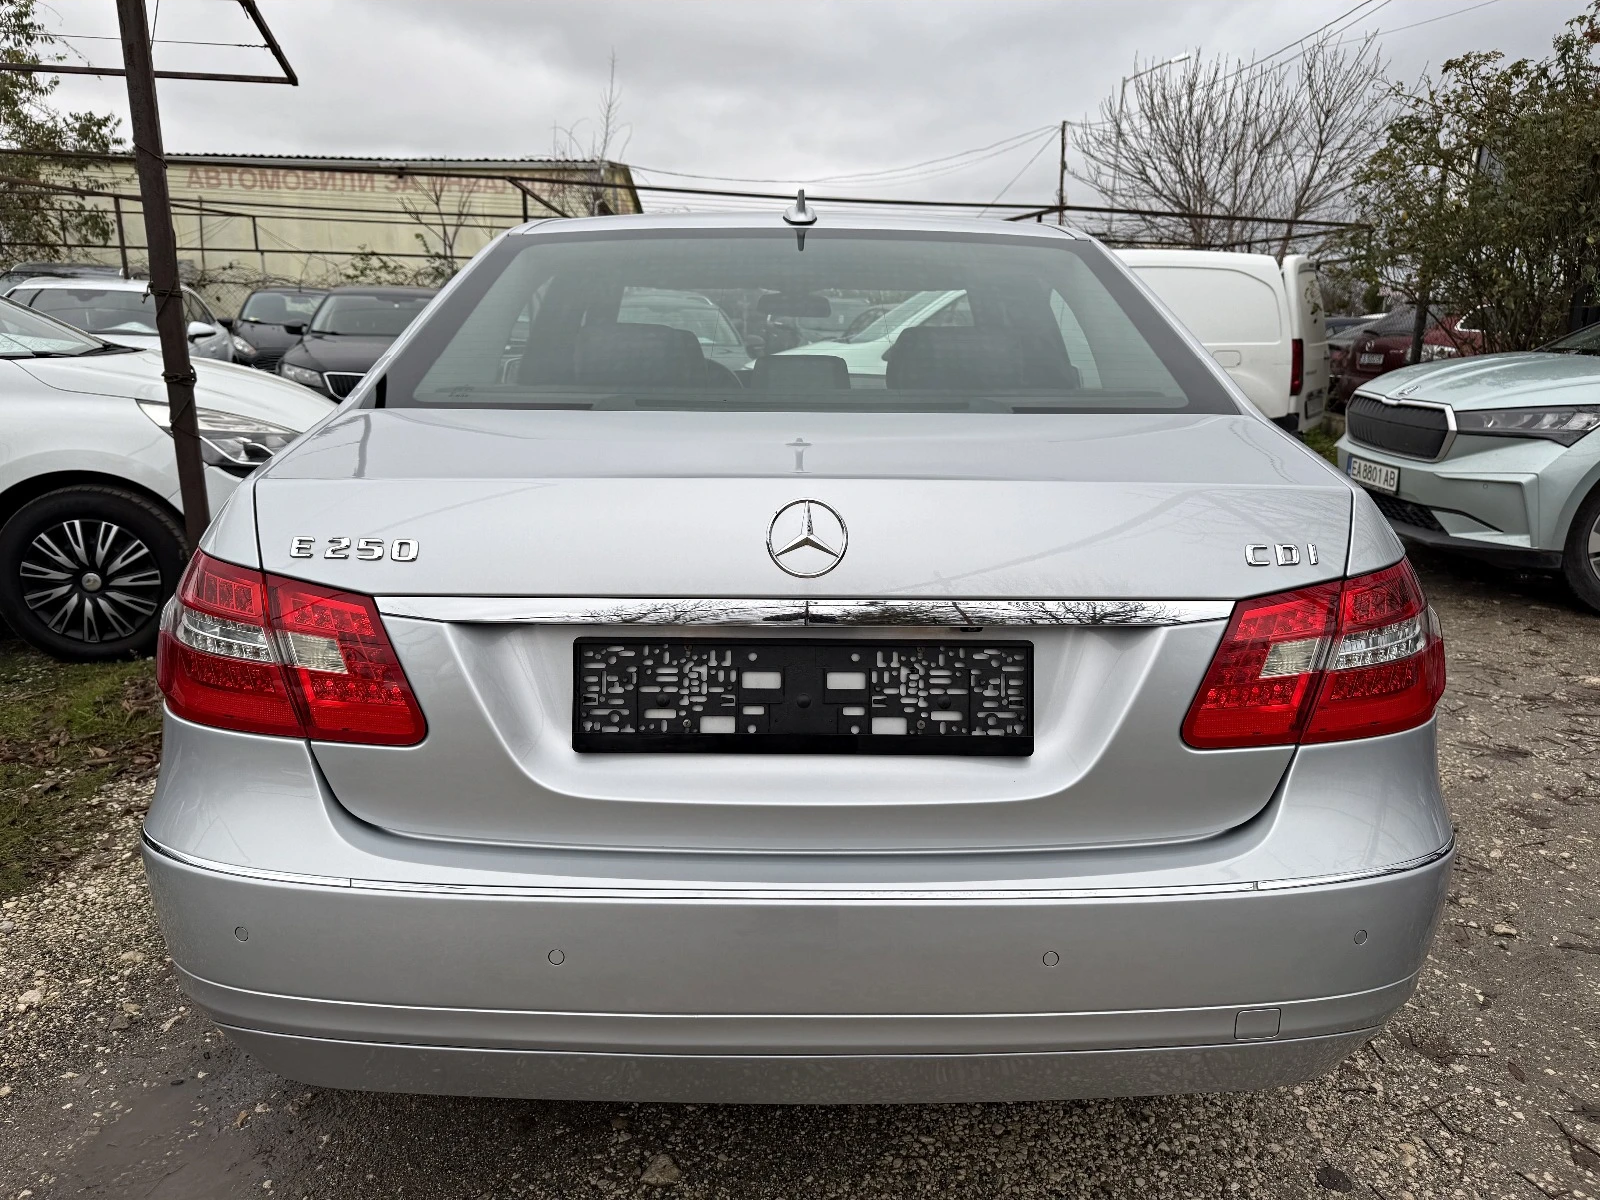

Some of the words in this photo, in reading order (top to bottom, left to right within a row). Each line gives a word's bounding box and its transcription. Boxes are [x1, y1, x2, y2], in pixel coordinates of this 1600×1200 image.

[186, 166, 376, 193] АВТОМОБИЛИ
[289, 536, 316, 559] E
[323, 537, 420, 563] 250
[1244, 543, 1319, 567] CDI
